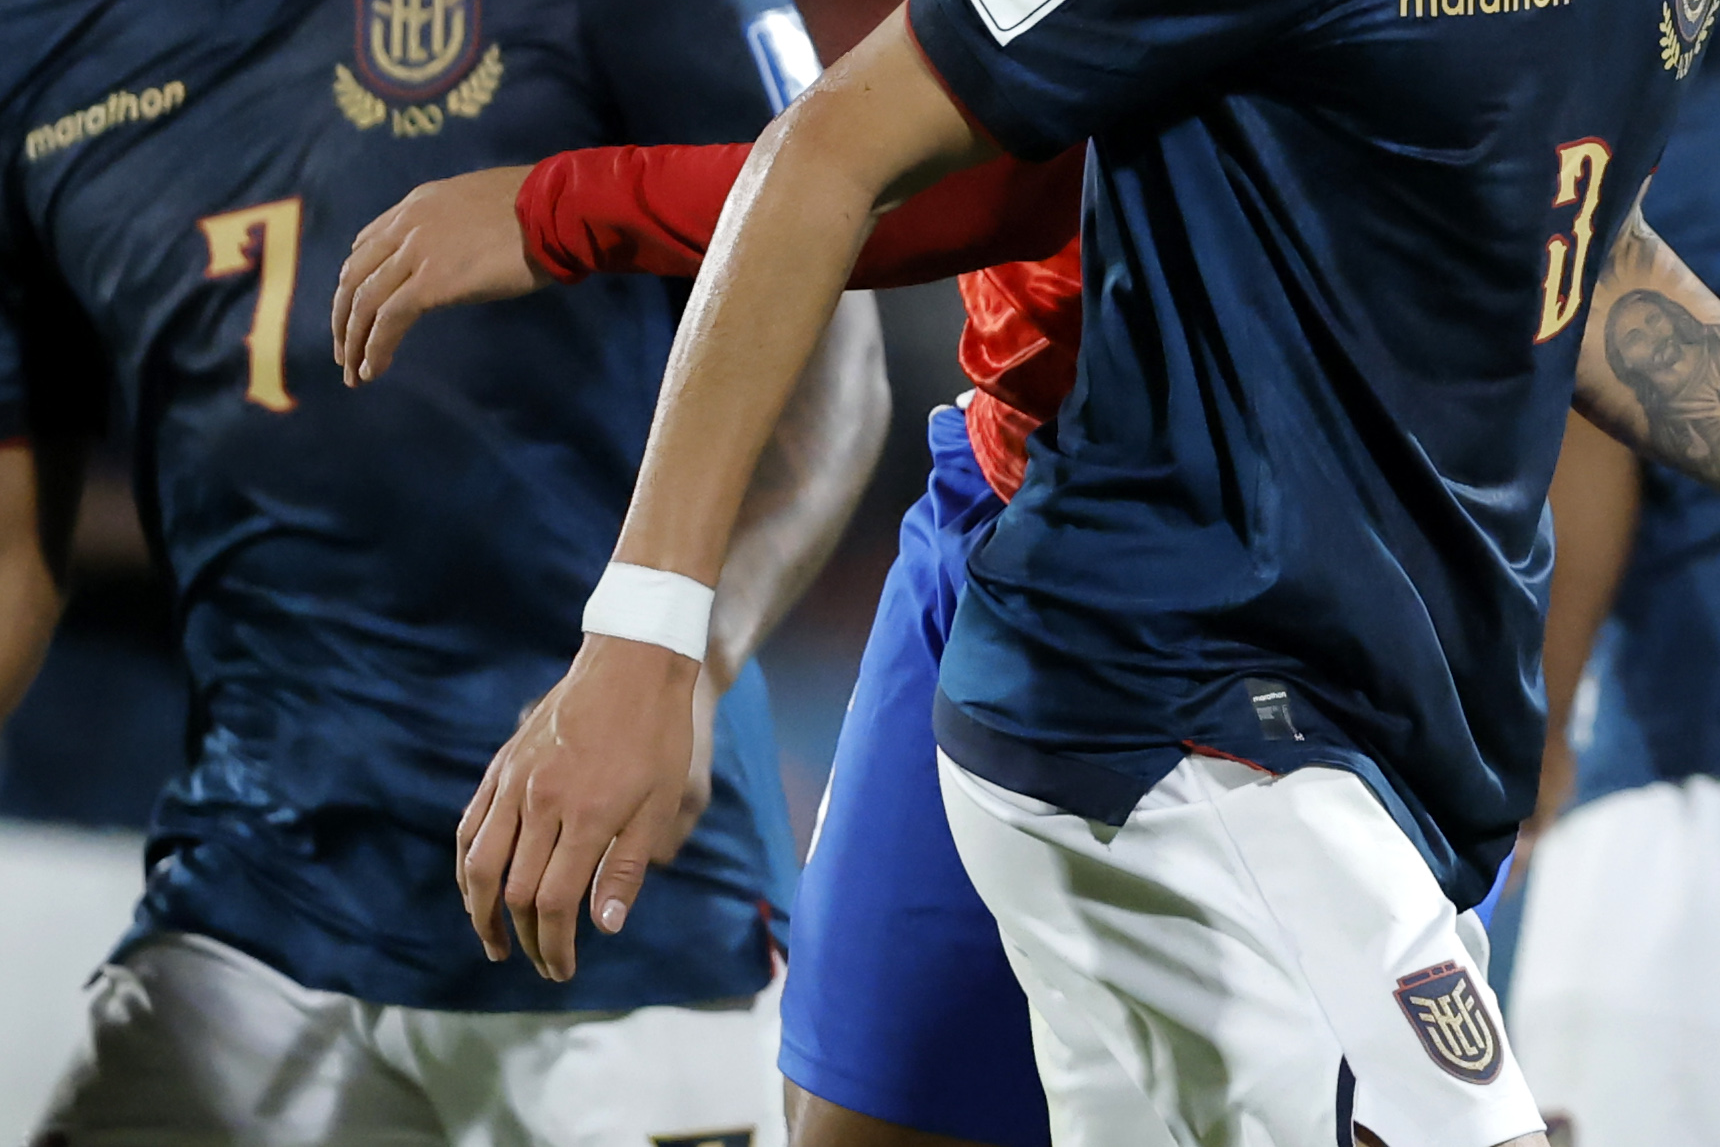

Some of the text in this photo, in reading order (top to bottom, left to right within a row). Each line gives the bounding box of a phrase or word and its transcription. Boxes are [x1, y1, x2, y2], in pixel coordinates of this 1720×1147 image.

[25, 80, 187, 163] marathon
[197, 196, 302, 413] 7
[1533, 136, 1613, 344] 3
